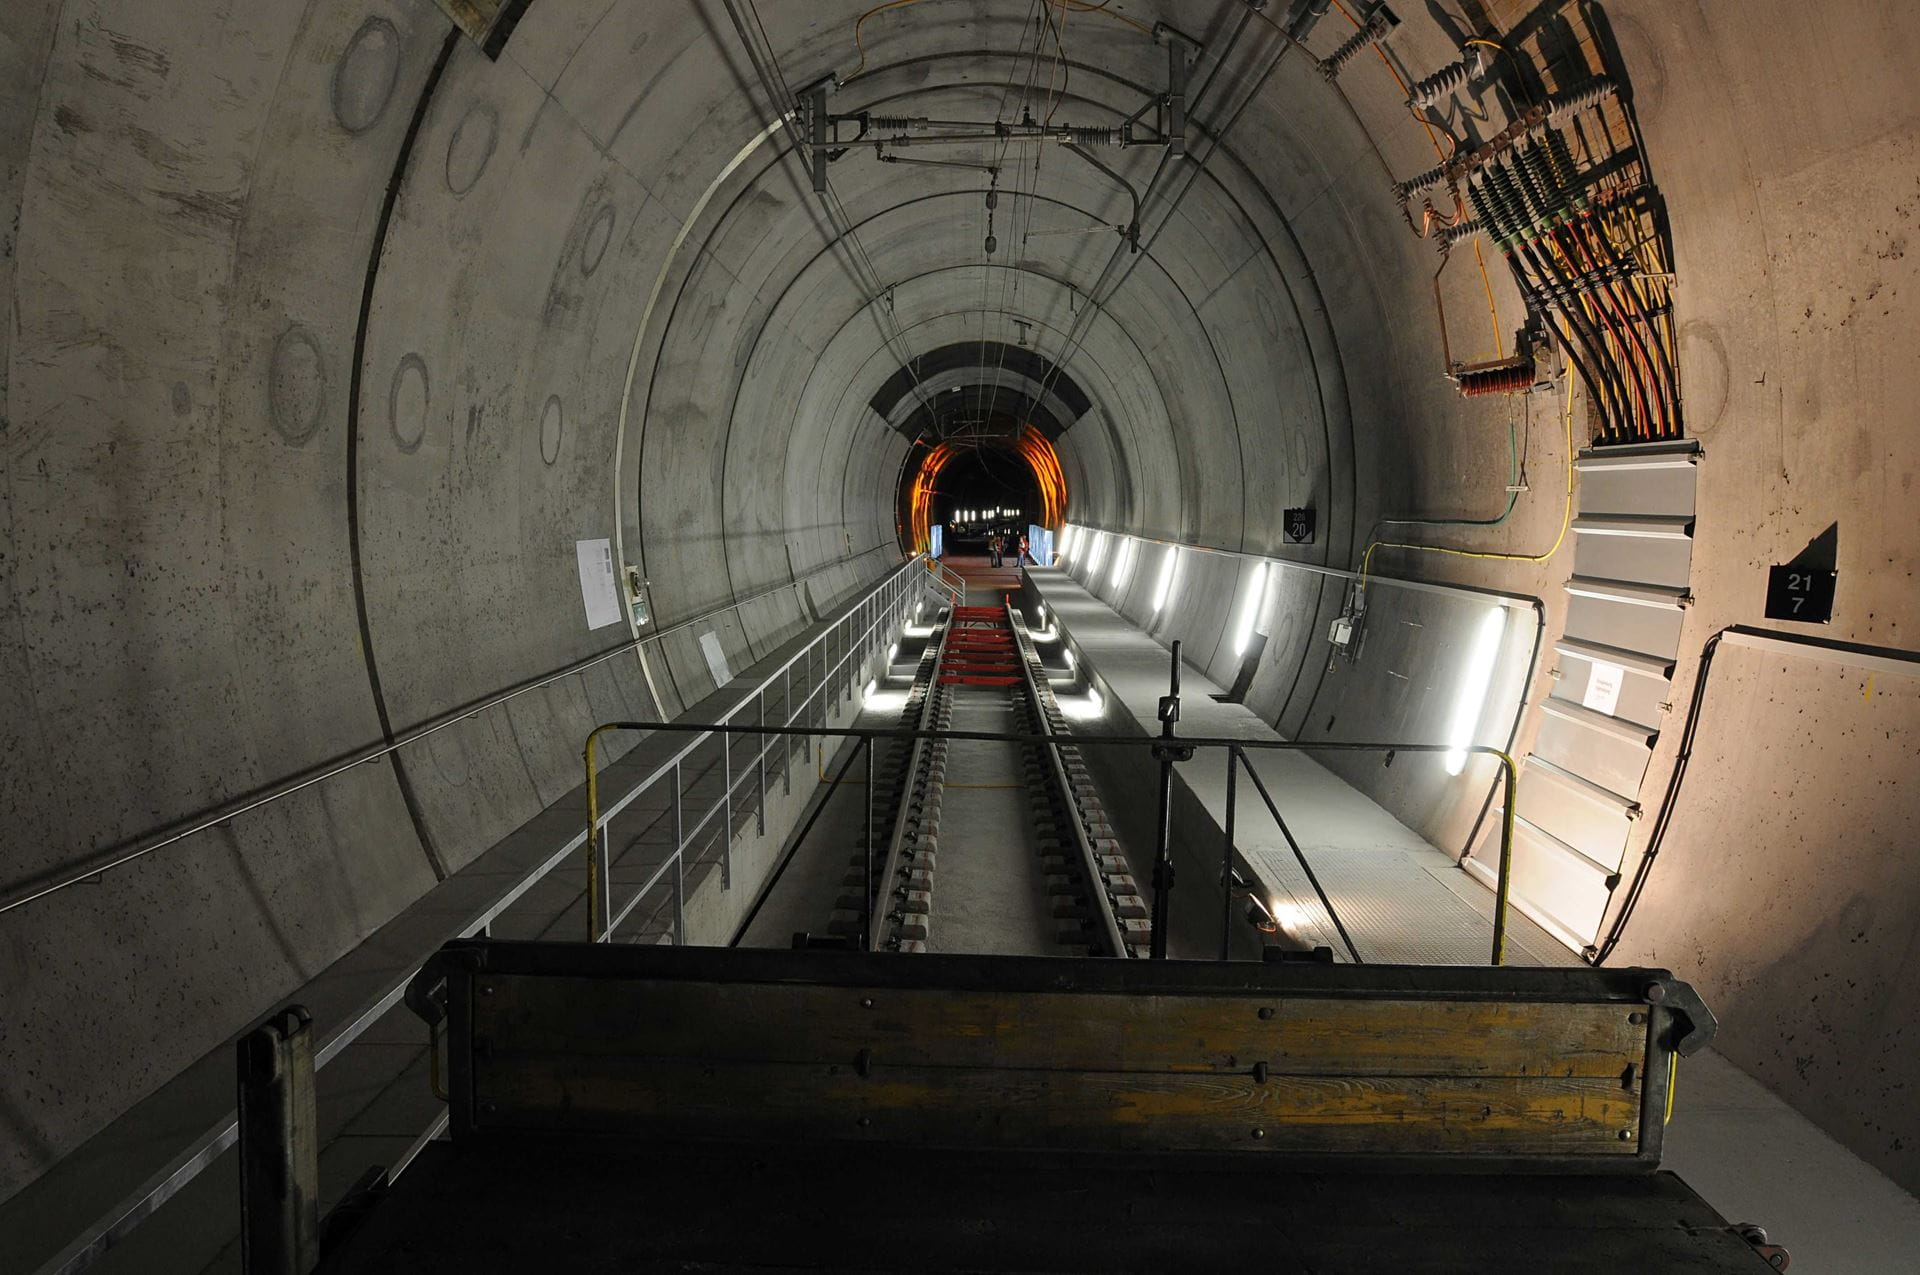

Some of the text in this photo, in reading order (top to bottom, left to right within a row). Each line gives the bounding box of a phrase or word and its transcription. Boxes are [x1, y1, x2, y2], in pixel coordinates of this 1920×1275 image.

[1292, 523, 1306, 537] 20
[1787, 573, 1812, 592] 21
[1791, 597, 1805, 613] 7
